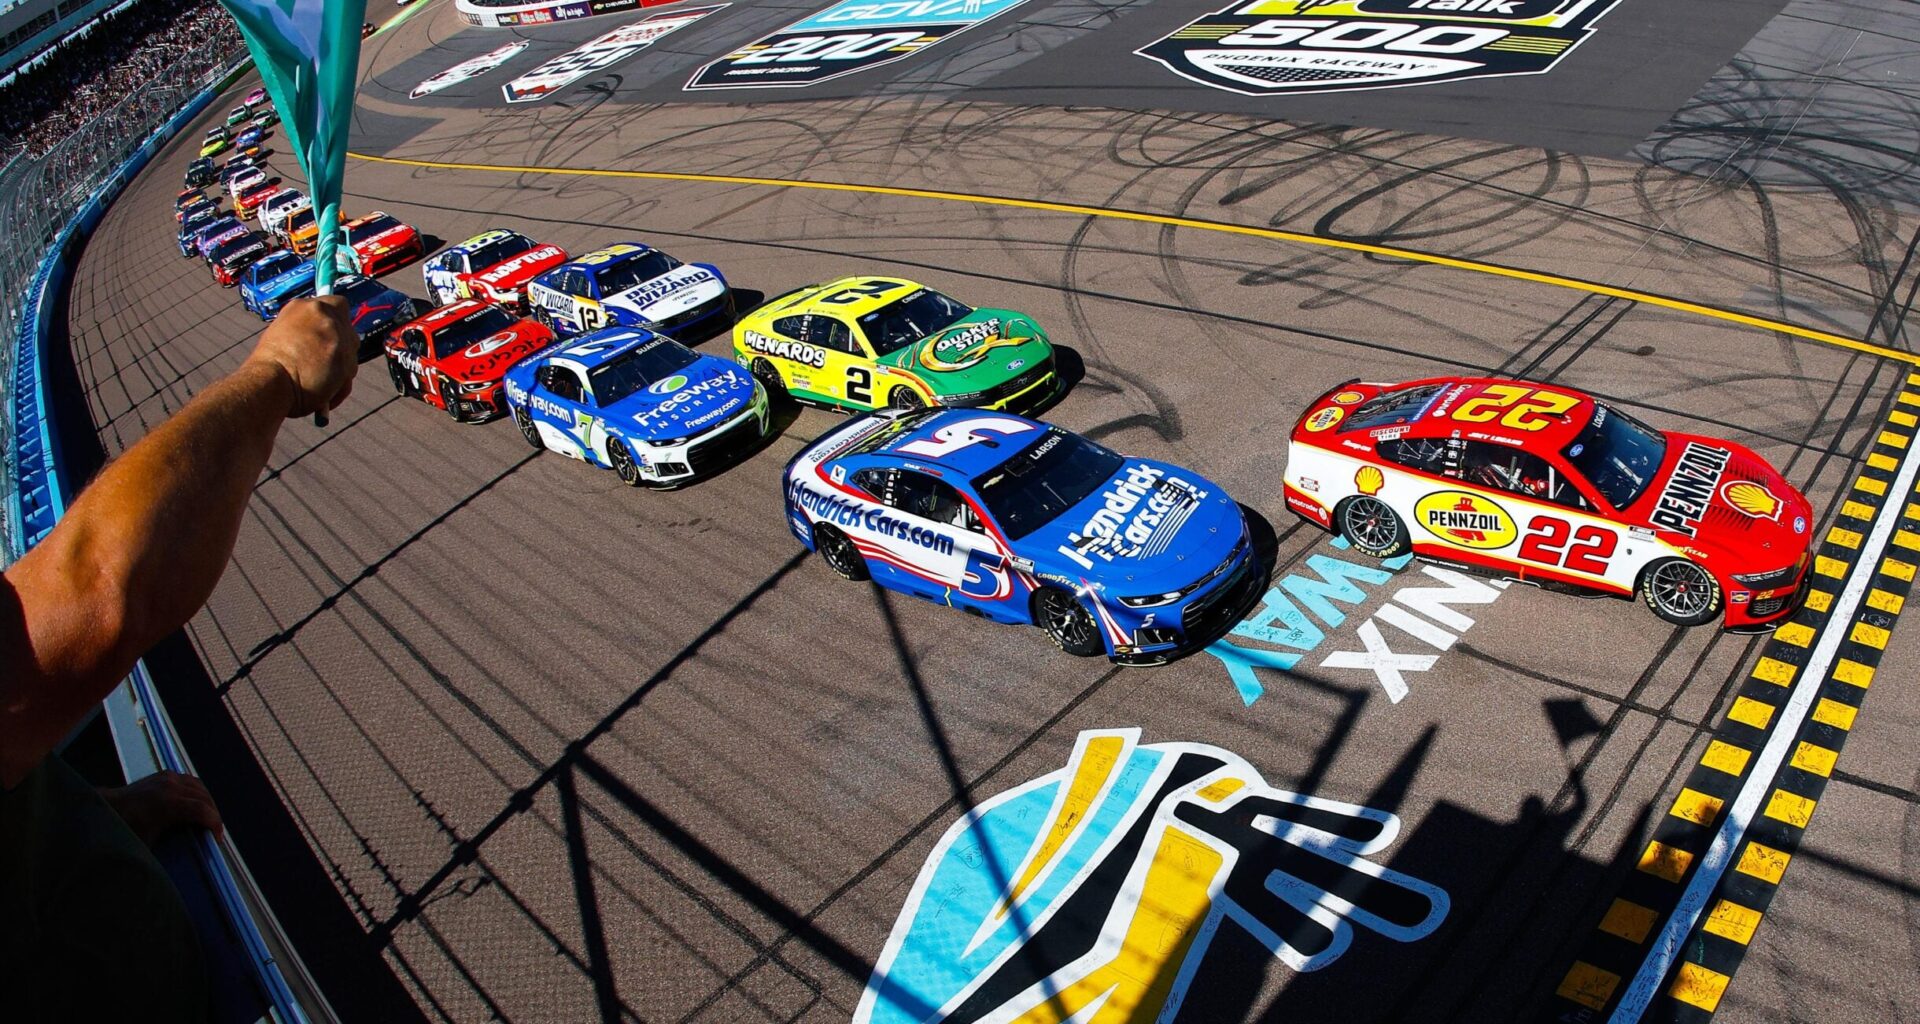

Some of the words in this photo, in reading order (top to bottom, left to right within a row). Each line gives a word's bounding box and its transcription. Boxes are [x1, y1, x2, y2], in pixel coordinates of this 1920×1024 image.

[731, 32, 926, 65] 200
[1217, 20, 1510, 54] 500
[1202, 53, 1303, 63] PHOENIX
[1310, 58, 1425, 70] RACEWAY
[480, 246, 561, 283] RAPTOR
[546, 292, 574, 314] WIZARD
[625, 275, 673, 300] DENT
[632, 271, 709, 306] WIZARD
[820, 280, 906, 304] 2
[579, 306, 599, 333] 12
[936, 318, 1000, 352] QUAKER
[562, 332, 642, 357] 7
[744, 330, 826, 368] MENARDS
[955, 325, 1000, 351] STATE
[460, 336, 551, 380] Kubota
[632, 370, 737, 427] Freeway
[846, 366, 872, 404] 2
[650, 377, 751, 435] INSURANCE
[684, 397, 741, 429] Freeway.com
[1451, 384, 1582, 432] 22
[577, 412, 593, 448] 7
[894, 417, 1037, 458] 5
[1342, 439, 1372, 452] Snap-on
[1369, 426, 1410, 438] DISCOUNT
[1030, 434, 1062, 461] LARSON
[1288, 496, 1319, 513] Autotrader
[1648, 442, 1732, 539] PENNZOIL
[1058, 464, 1165, 571] Hendrick
[1111, 476, 1191, 558] Cars.com
[1429, 510, 1502, 532] PENNZOIL
[1518, 514, 1618, 577] 22
[960, 547, 1011, 600] 5
[1037, 573, 1082, 592] GOODYEAR
[1755, 590, 1775, 600] 22
[1141, 613, 1155, 628] 5
[1204, 545, 1400, 707] WAY
[1319, 565, 1505, 704] NIX
